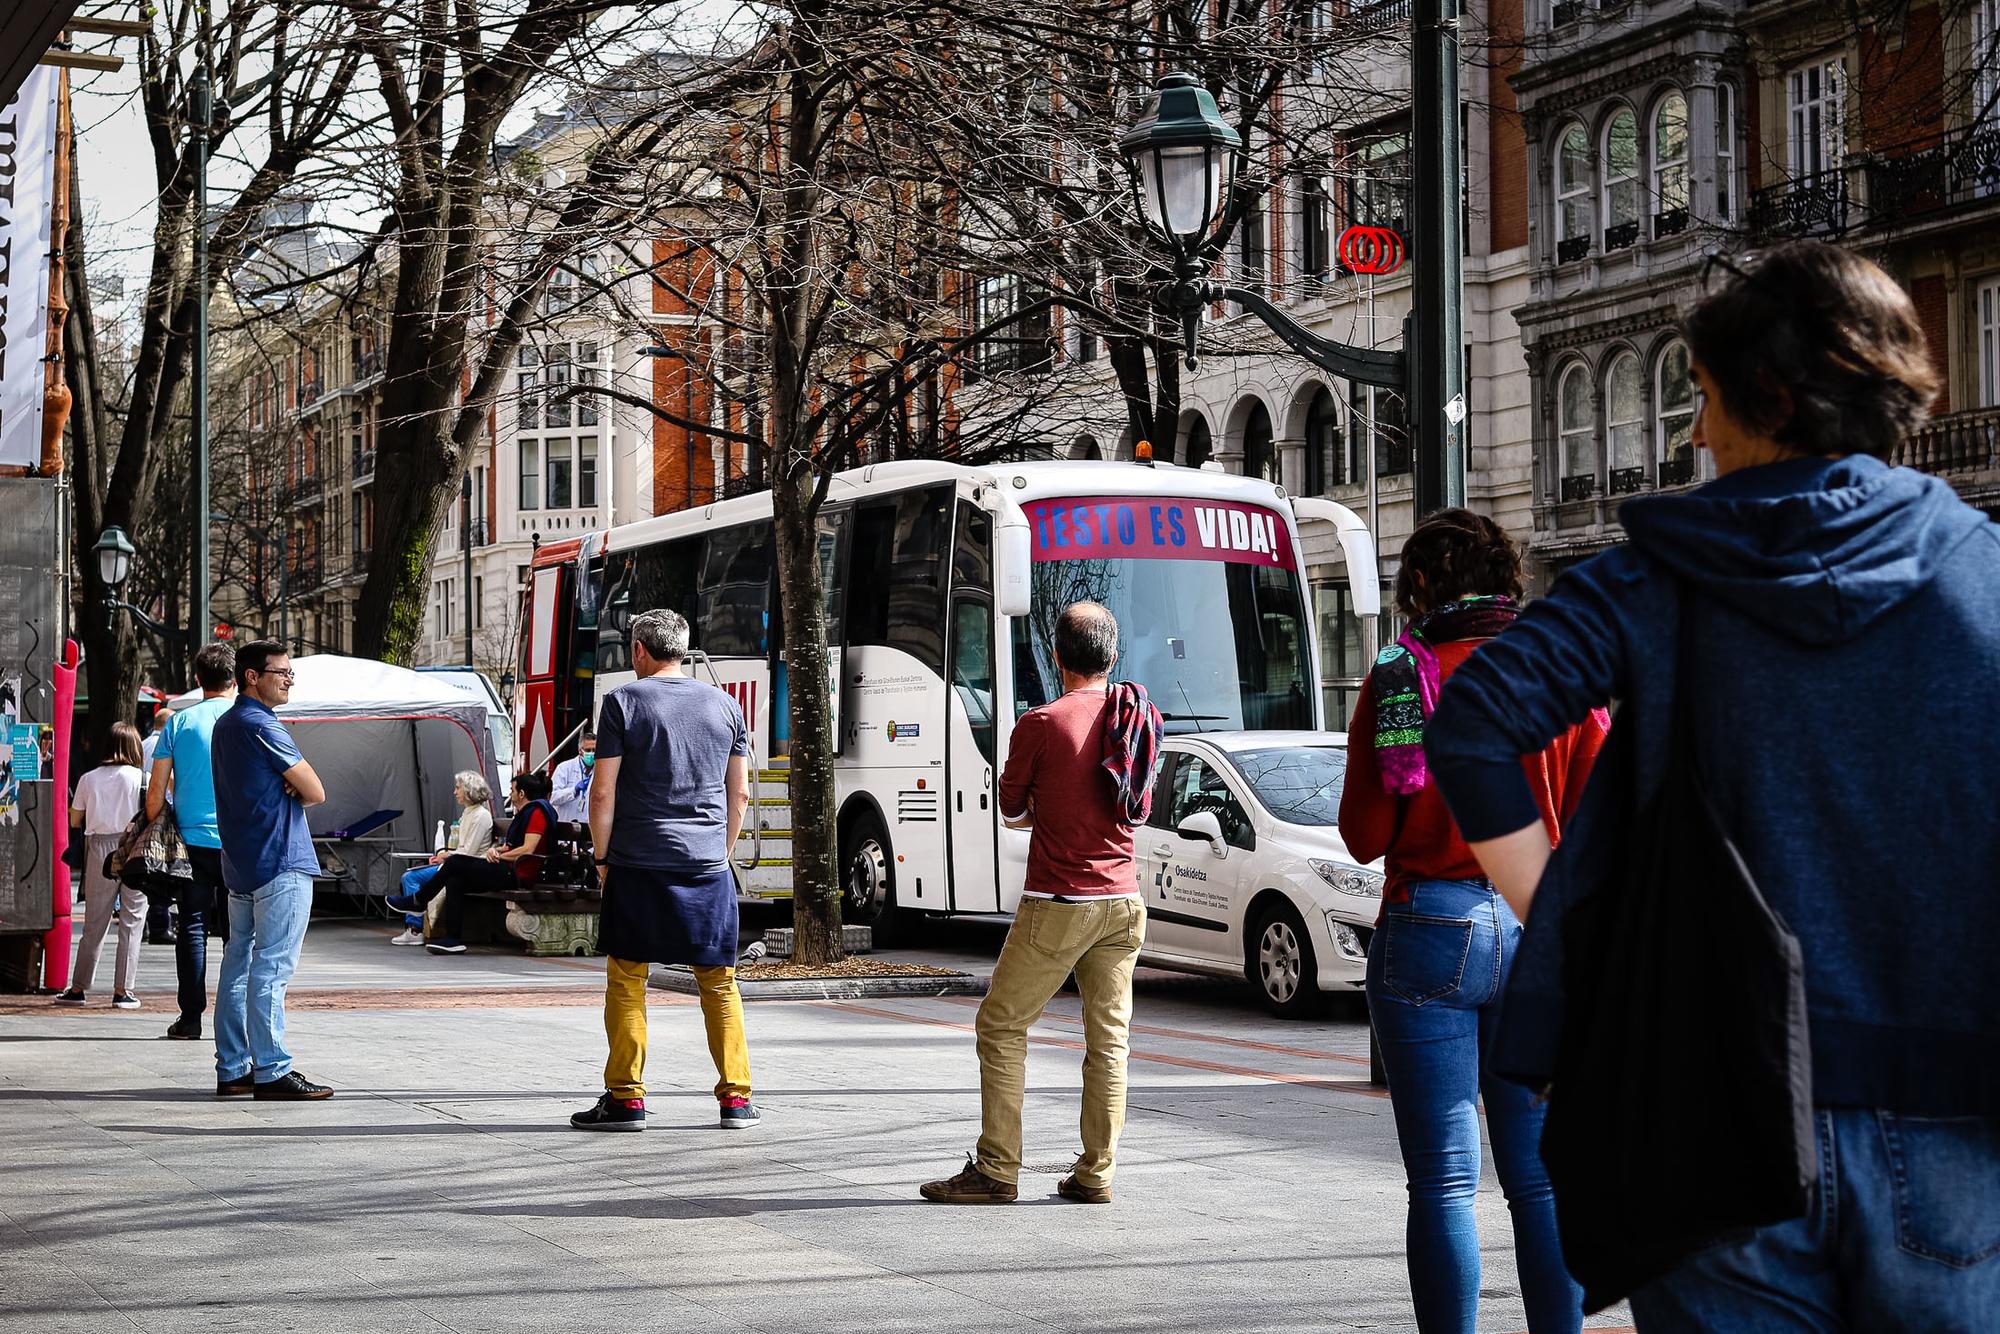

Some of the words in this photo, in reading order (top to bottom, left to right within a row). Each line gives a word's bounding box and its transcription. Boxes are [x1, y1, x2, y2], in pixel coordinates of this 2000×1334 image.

[1035, 505, 1136, 549] ¡ESTO
[1150, 506, 1186, 547] ES
[1194, 507, 1279, 562] VIDA!
[1175, 865, 1207, 881] Osakidetza
